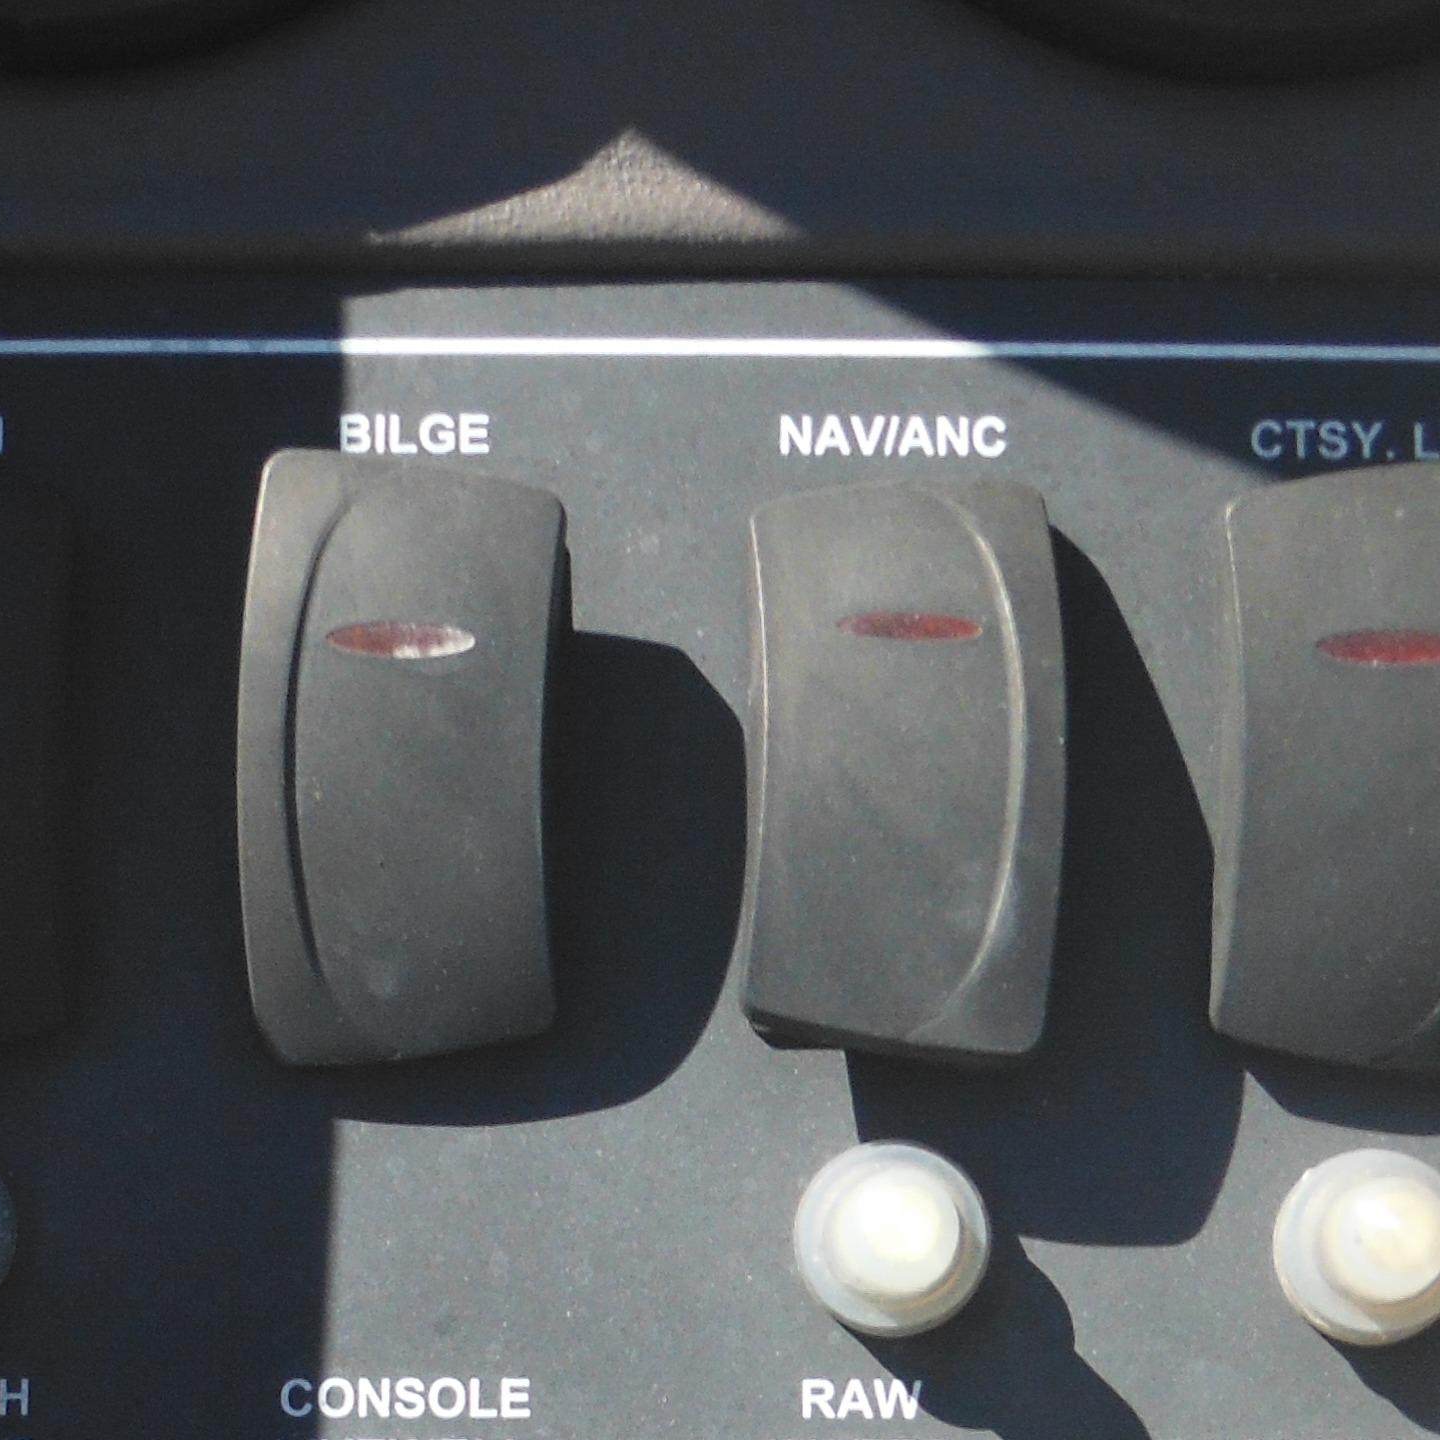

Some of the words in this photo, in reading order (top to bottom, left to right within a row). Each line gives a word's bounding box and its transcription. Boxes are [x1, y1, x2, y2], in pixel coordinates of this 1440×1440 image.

[339, 411, 491, 456] BILGE
[779, 413, 1008, 458] NAV/ANC
[1250, 418, 1397, 460] CTSY.
[280, 1376, 531, 1419] CONSOLE
[801, 1377, 923, 1420] RAW
